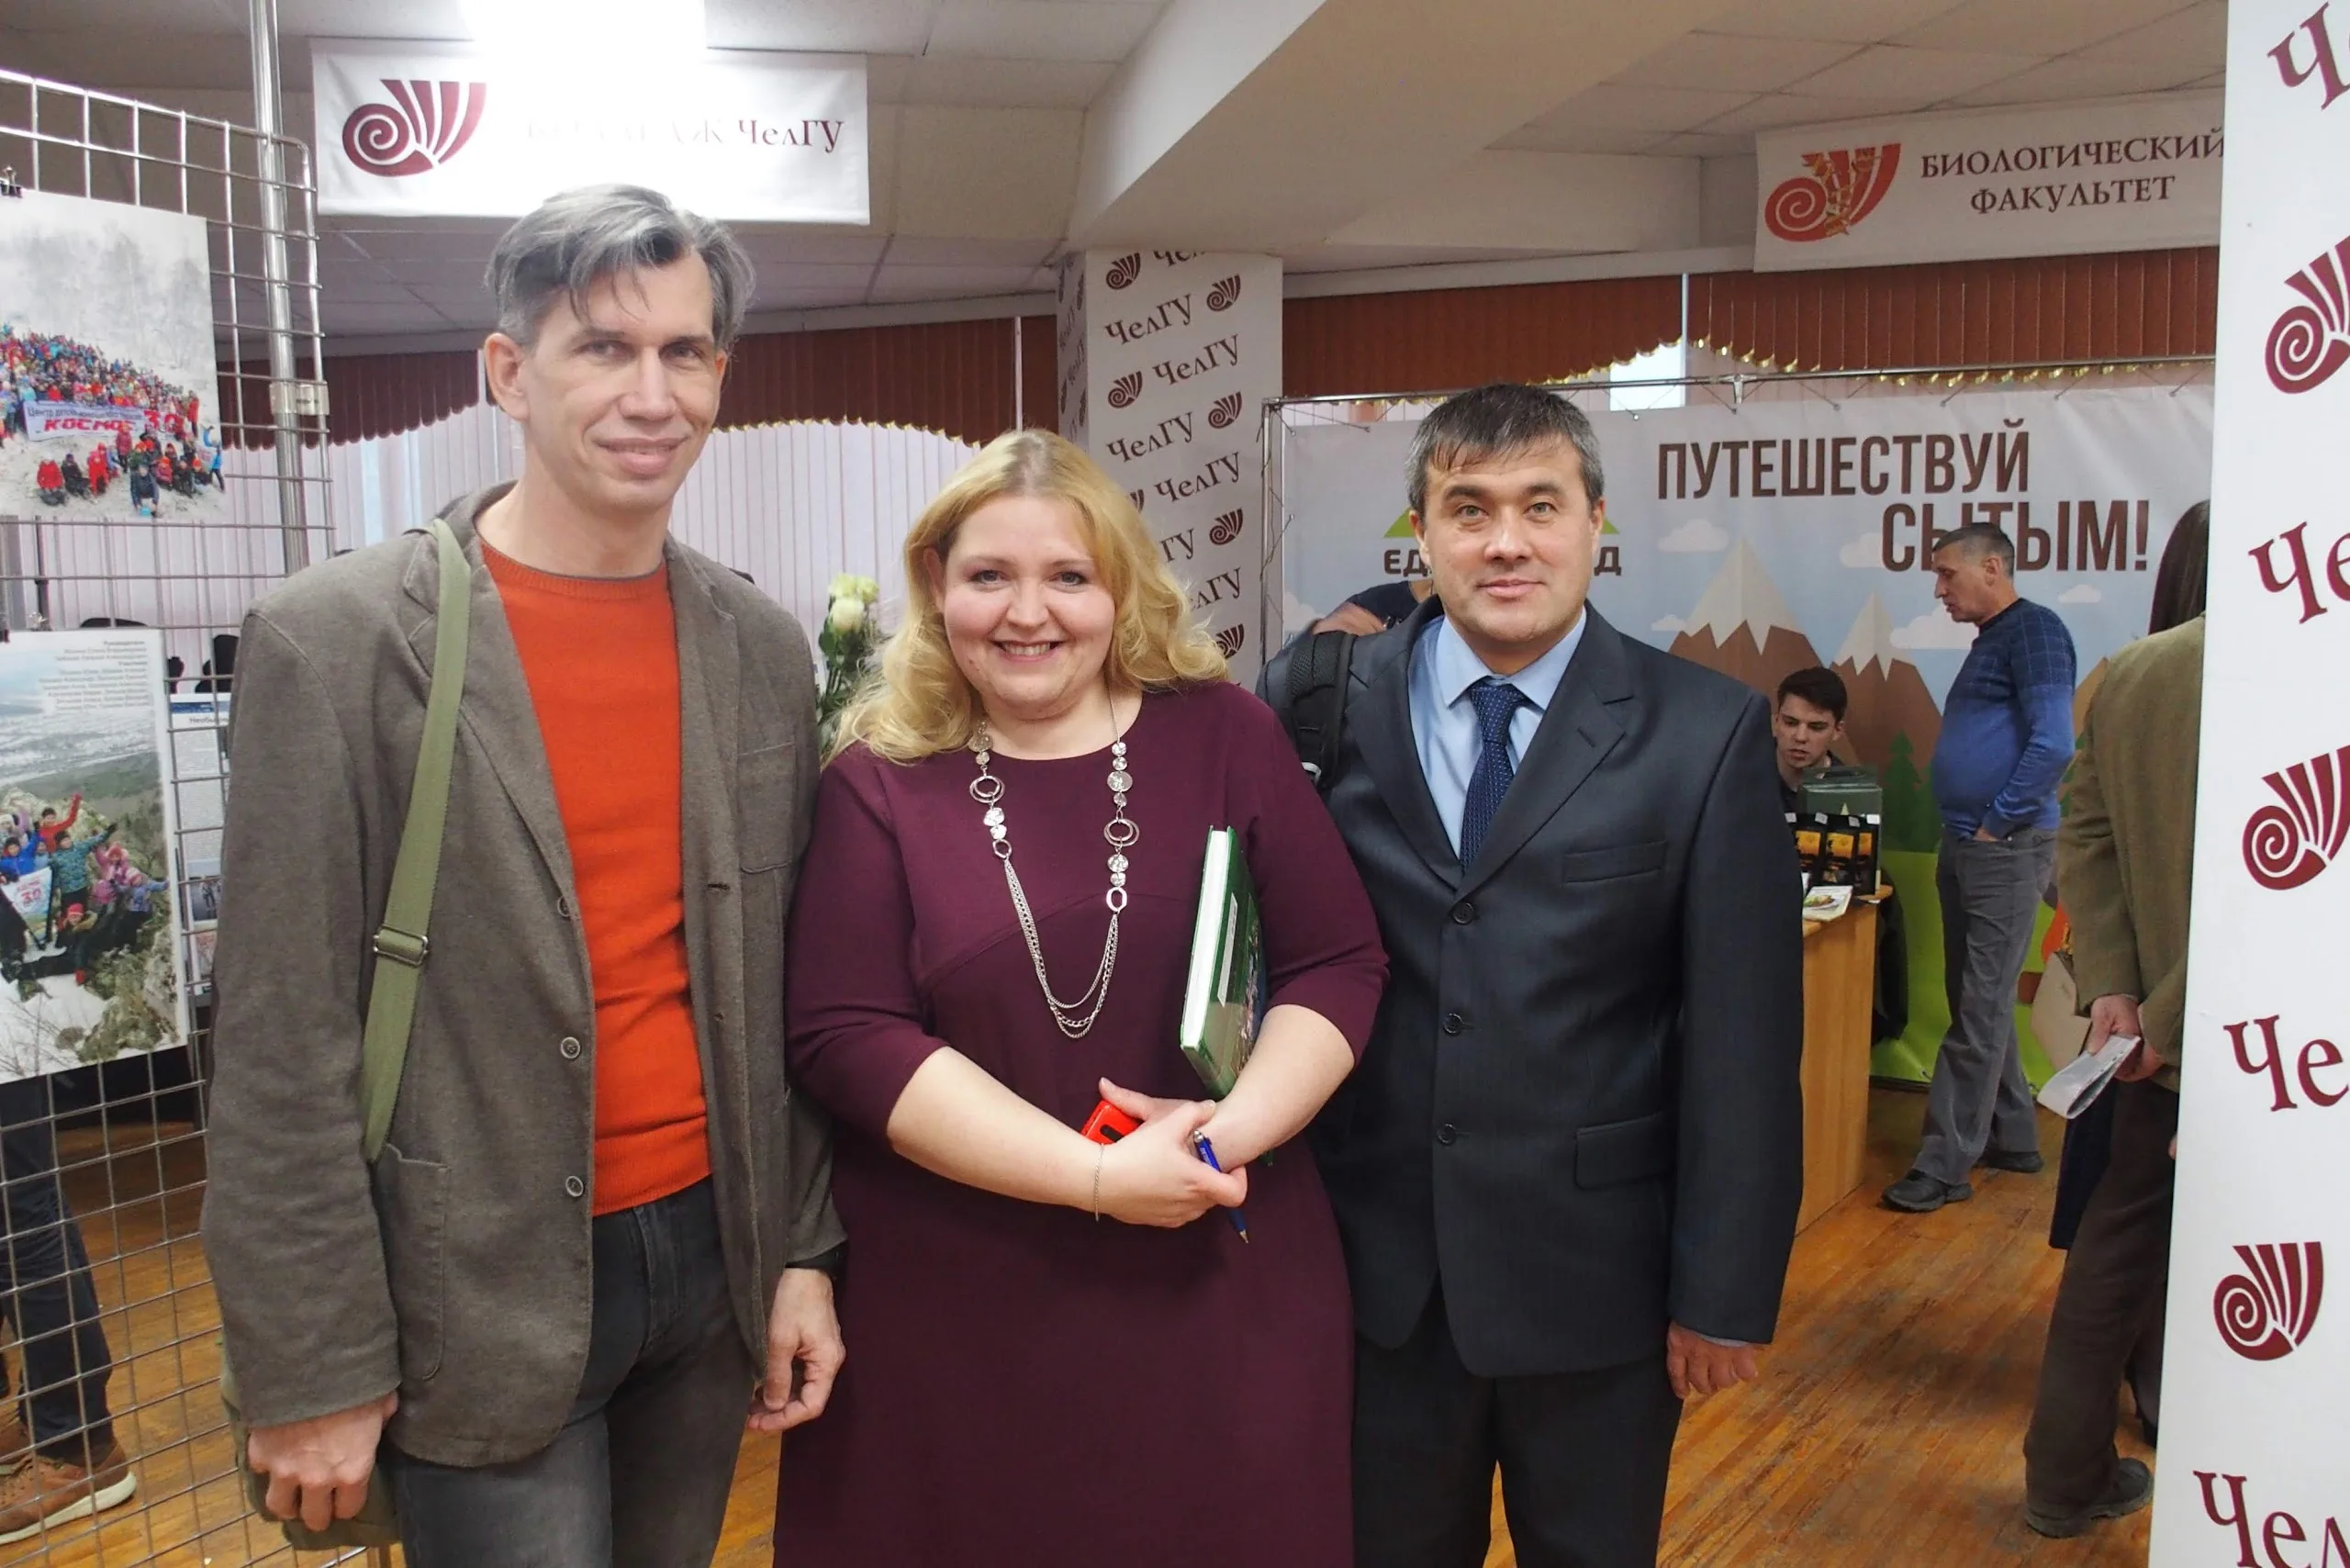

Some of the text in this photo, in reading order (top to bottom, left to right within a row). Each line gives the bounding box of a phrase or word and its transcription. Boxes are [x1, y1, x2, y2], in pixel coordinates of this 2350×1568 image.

[739, 120, 845, 152] ЧелГУ
[1920, 126, 2223, 178] БИОЛОГИЧЕСКИЙ
[1971, 175, 2176, 214] ФАКУЛЬТЕТ
[1104, 294, 1192, 345] ЧелГУ
[1155, 334, 1239, 386] ЧелГУ
[1107, 412, 1193, 463] ЧелГУ
[1658, 420, 2030, 500] ПУТЕШЕСТВУЙ
[1154, 453, 1240, 502] ЧелГУ
